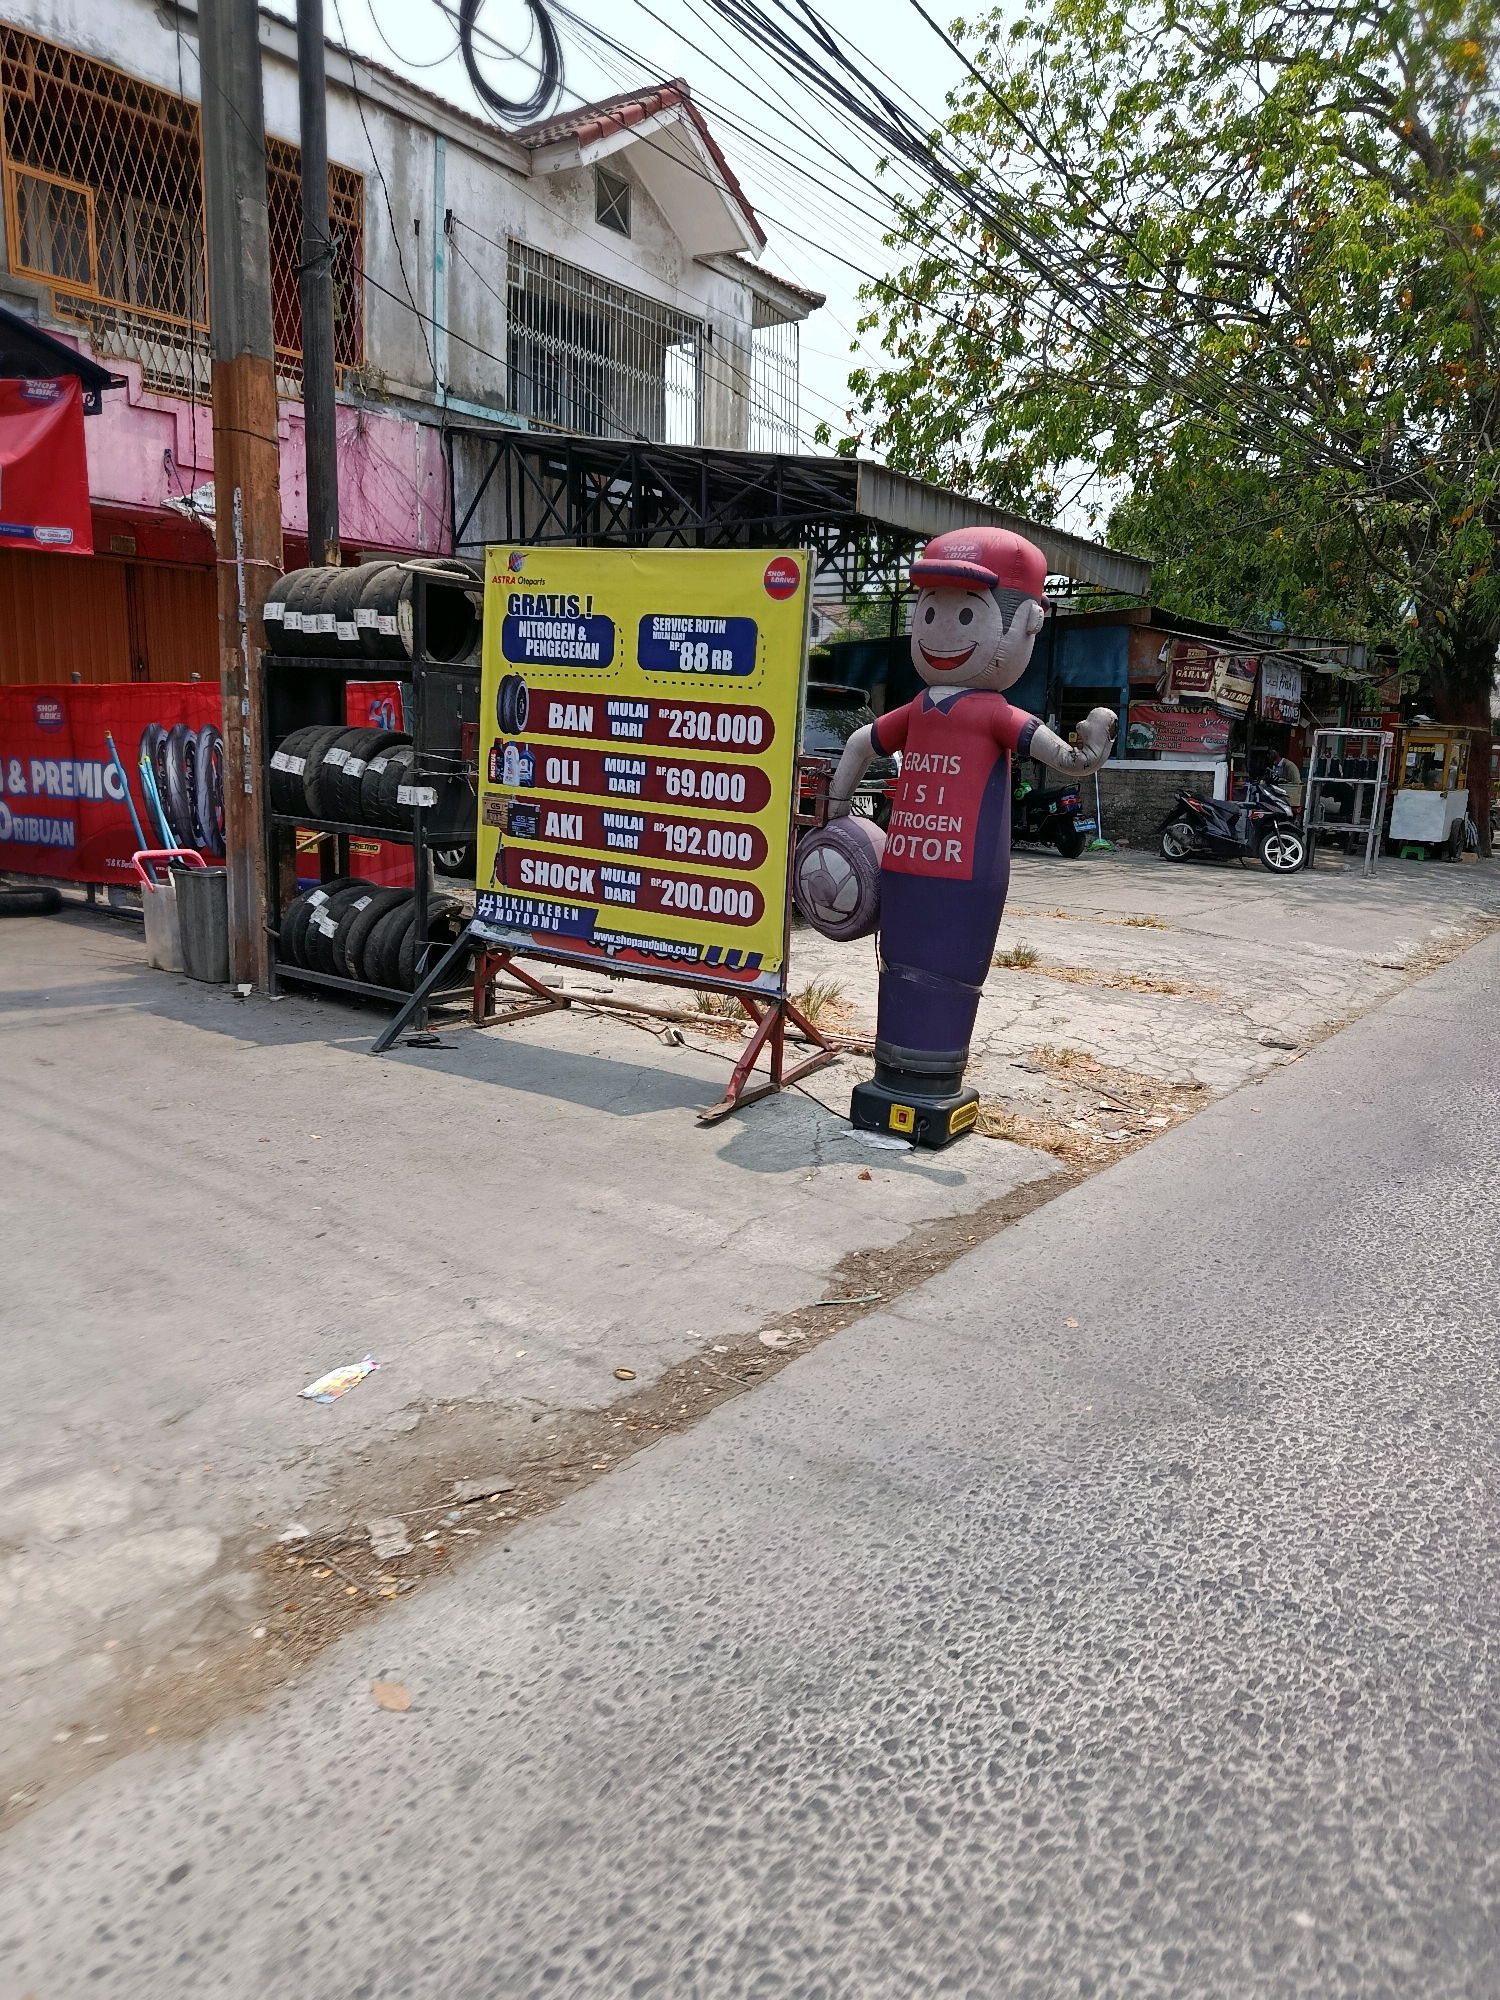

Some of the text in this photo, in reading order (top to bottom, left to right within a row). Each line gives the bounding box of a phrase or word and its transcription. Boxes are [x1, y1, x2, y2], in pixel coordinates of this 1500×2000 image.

[26, 380, 57, 390] SHOP
[942, 545, 975, 553] SHOP
[492, 575, 546, 587] ASTRA Otoparts
[507, 592, 580, 619] GRATIS
[518, 620, 587, 641] NITROGEN &
[652, 617, 727, 634] SERVICE RUTIN
[652, 631, 686, 641] MULAI DARI
[525, 639, 600, 661] PENGECEKAN
[711, 649, 733, 671] RB
[1175, 669, 1210, 680] GARAM
[37, 704, 58, 712] SHOP
[548, 702, 594, 732] BAN
[607, 701, 649, 719] MULAI
[611, 721, 643, 738] DARI
[1352, 717, 1382, 728] AYAM
[545, 757, 580, 787] OLI
[604, 757, 646, 776] MULAI
[904, 751, 962, 775] GRATIS
[30, 760, 128, 801] PREMIO
[608, 777, 641, 794] DARI
[544, 811, 583, 841] AKI
[603, 812, 644, 832] MULAI
[889, 810, 963, 833] NITROGEN
[607, 832, 639, 850] DARI
[885, 832, 963, 863] MOTOR
[520, 858, 596, 895] SHOCK
[600, 866, 641, 886] MULAI
[604, 885, 636, 904] DARI
[494, 907, 559, 931] MOTORMU
[538, 902, 579, 921] KEREN
[593, 931, 698, 958] www.shopandbike.co.id
